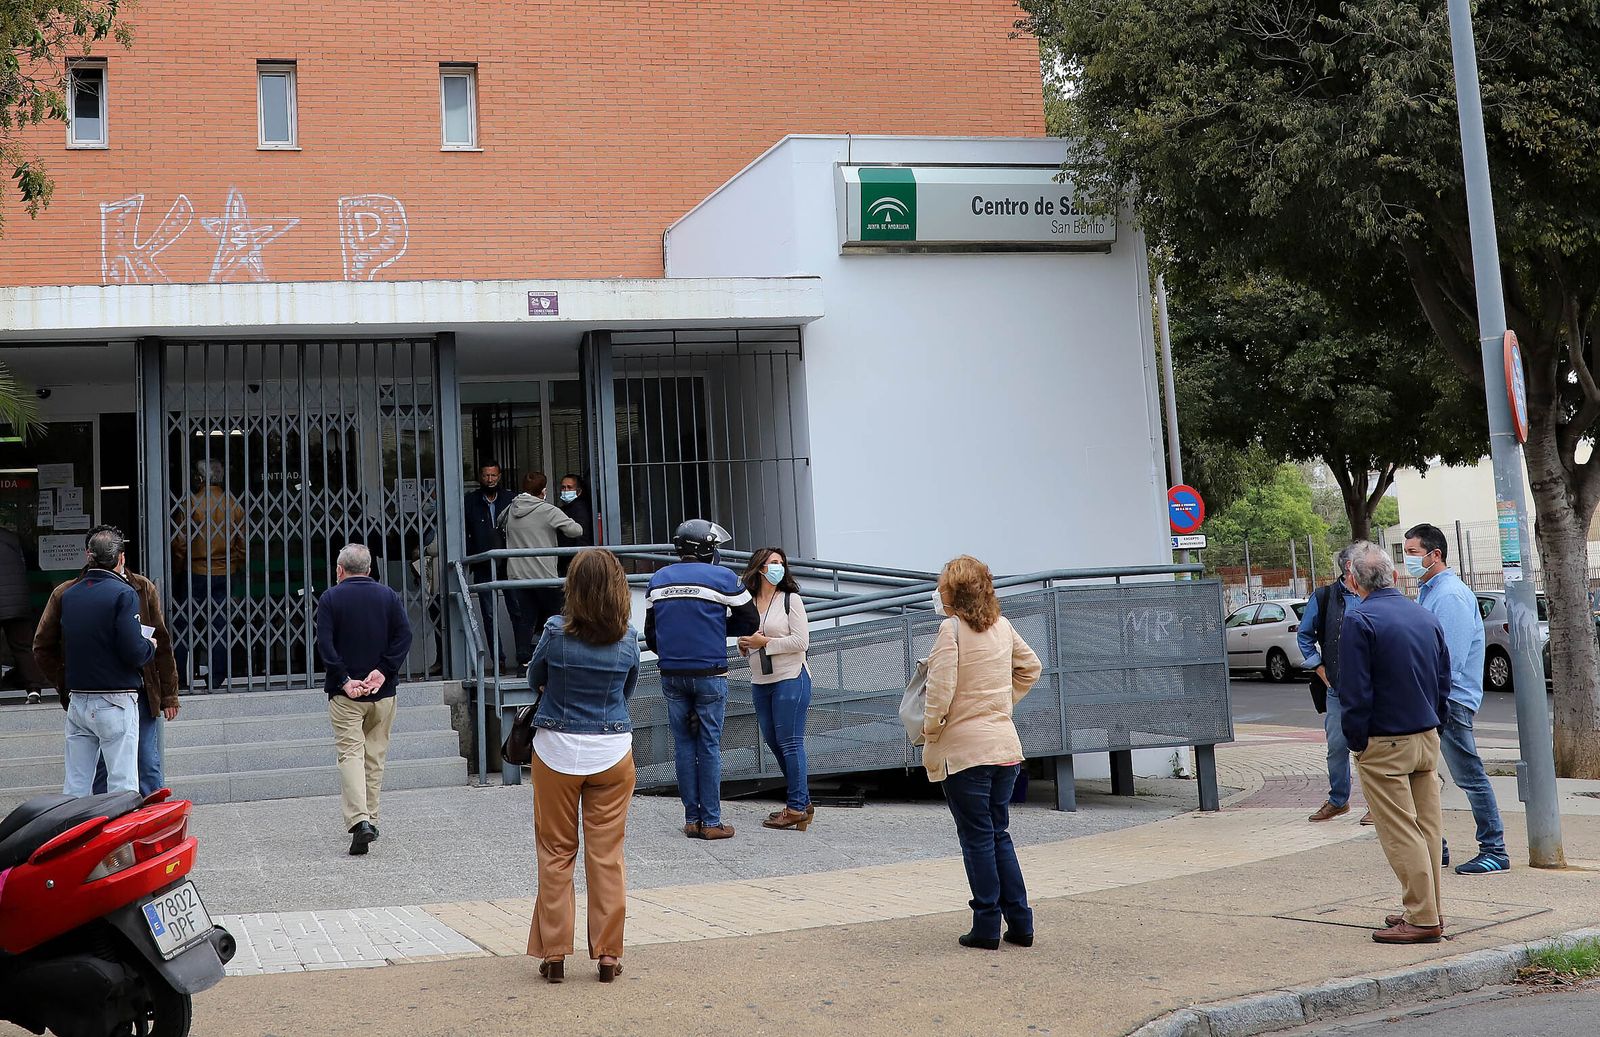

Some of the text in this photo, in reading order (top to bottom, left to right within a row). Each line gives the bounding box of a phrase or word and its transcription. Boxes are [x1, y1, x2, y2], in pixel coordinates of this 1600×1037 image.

[971, 195, 1029, 216] Centro
[1034, 196, 1054, 216] de
[1051, 219, 1105, 234] San Benito
[261, 471, 304, 481] ENTAD
[156, 888, 197, 923] 7802
[168, 911, 195, 942] DPF
